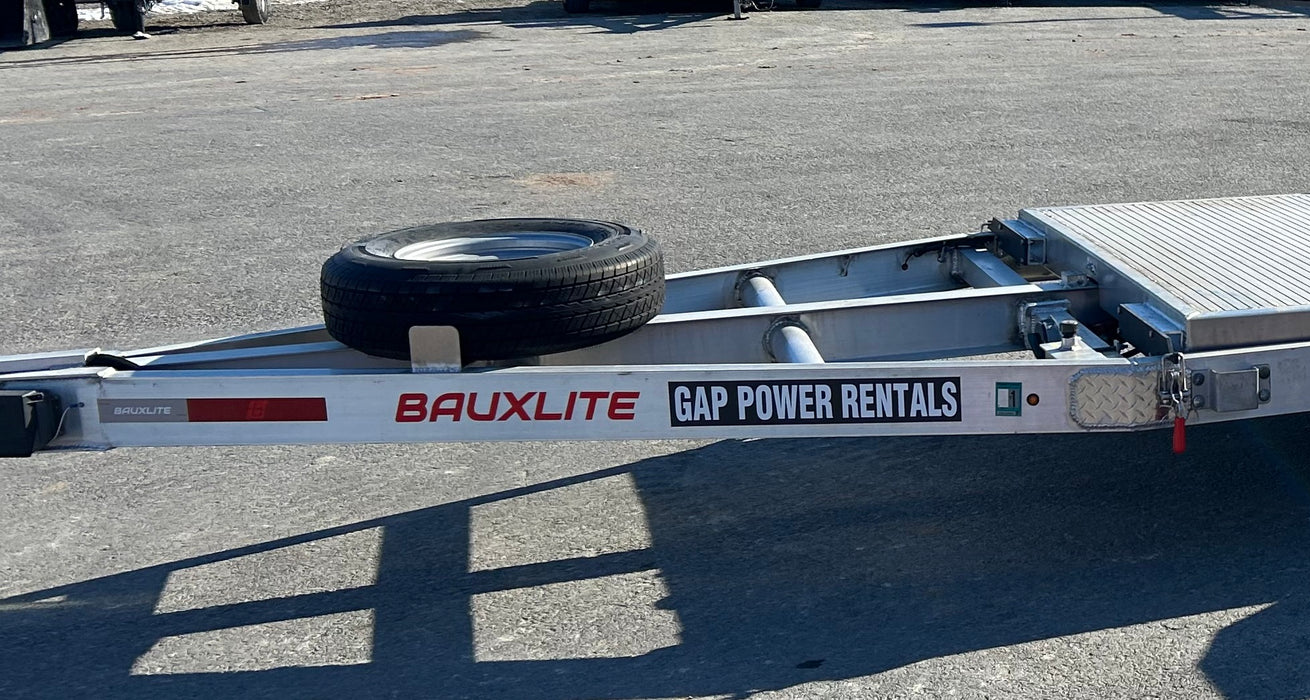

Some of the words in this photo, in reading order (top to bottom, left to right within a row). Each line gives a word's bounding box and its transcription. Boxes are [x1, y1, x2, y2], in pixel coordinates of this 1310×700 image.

[113, 406, 172, 415] BAUXLITE
[395, 391, 640, 423] BAUXLITE
[674, 385, 728, 422] GAP
[737, 384, 833, 421] POWER
[841, 381, 958, 419] RENTALS
